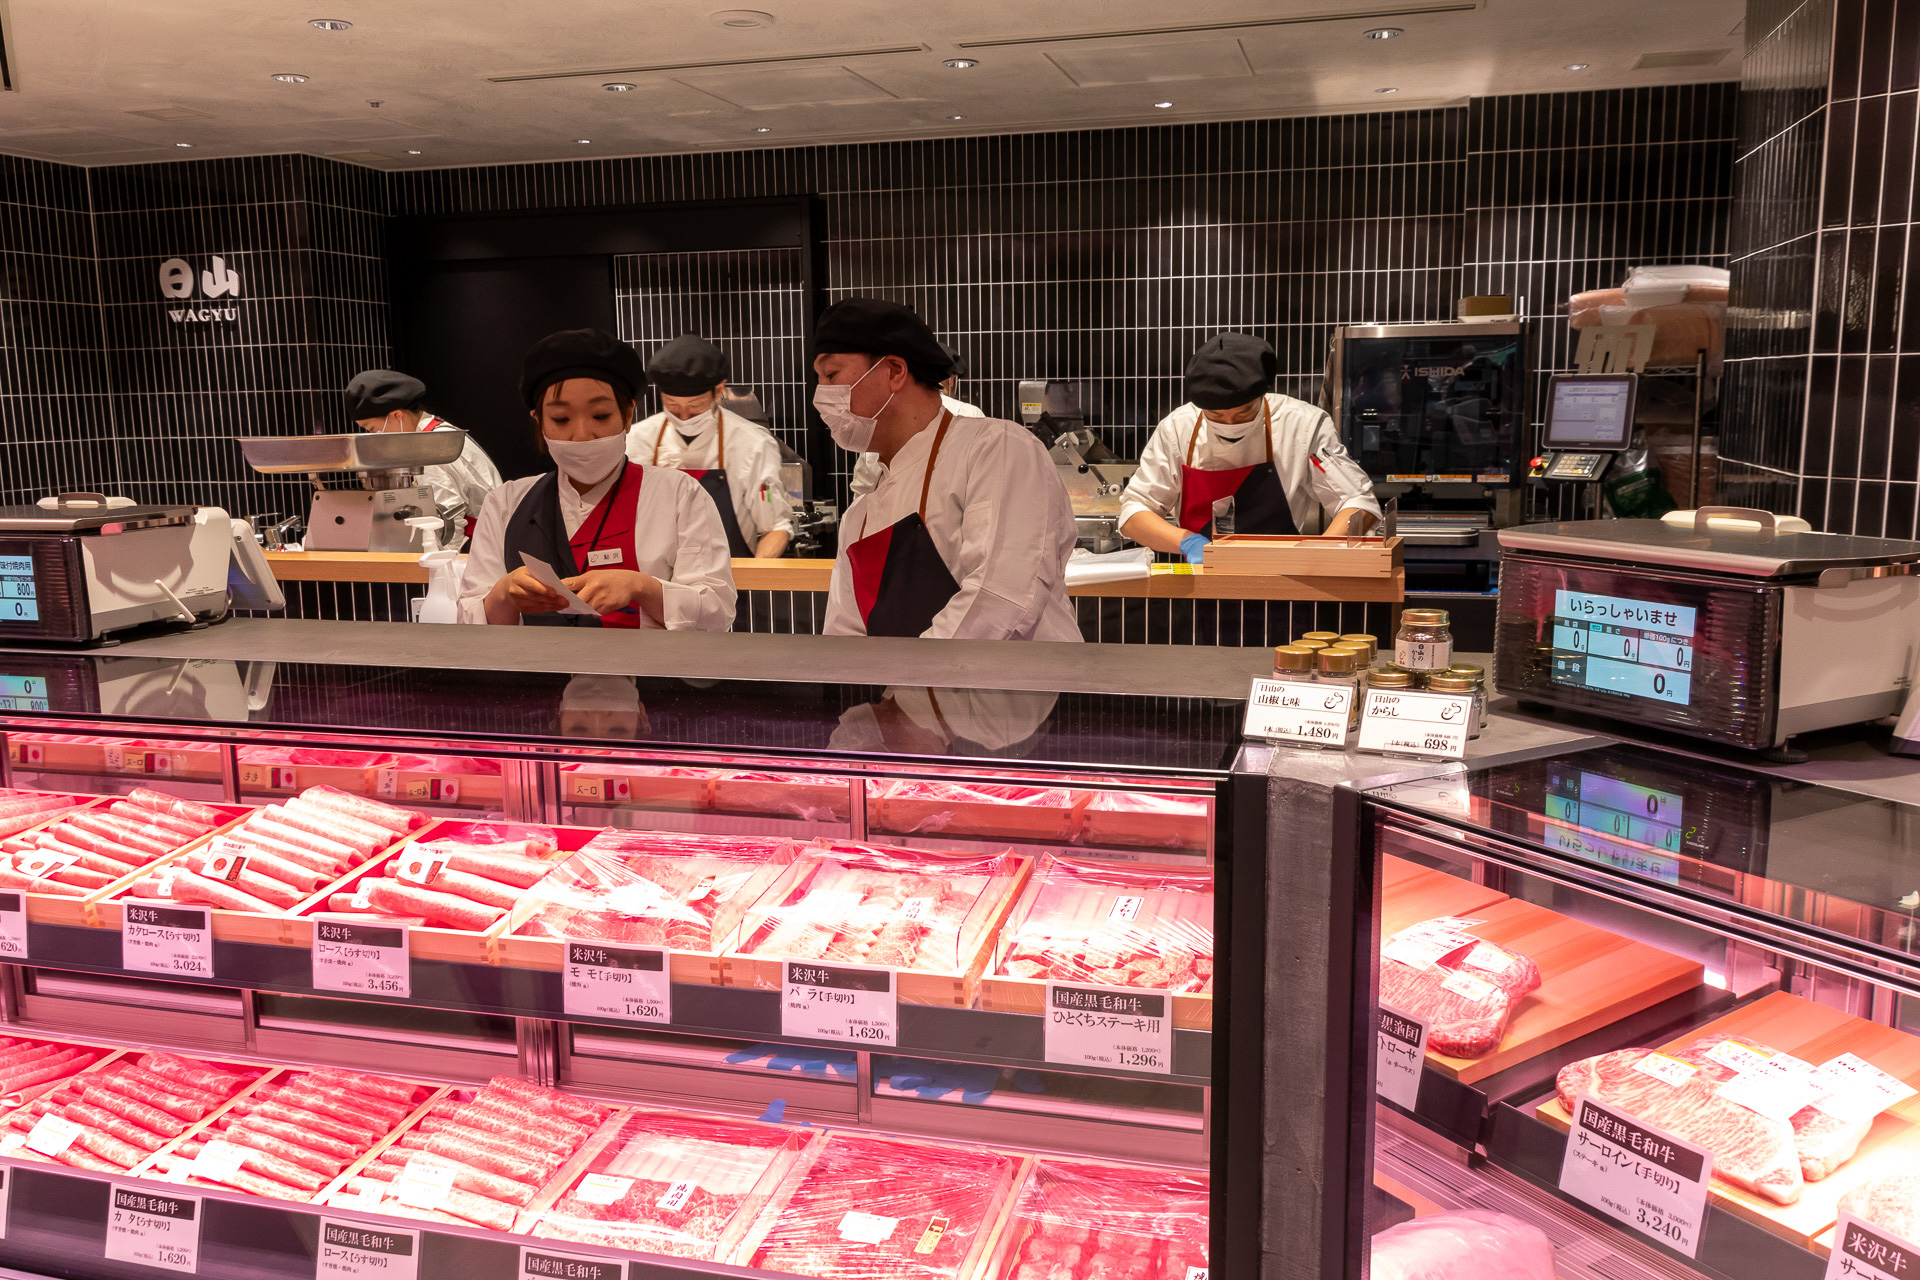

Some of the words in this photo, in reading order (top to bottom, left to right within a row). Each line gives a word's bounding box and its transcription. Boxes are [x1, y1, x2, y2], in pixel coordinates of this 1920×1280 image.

[159, 255, 239, 298] 日山
[168, 308, 237, 322] WAGYU
[1414, 366, 1465, 377] ISHIDA
[1570, 598, 1677, 627] いらっしゃいませ
[1260, 684, 1285, 692] 日山の
[1374, 695, 1400, 704] 日山の
[1371, 705, 1400, 717] からし
[129, 907, 158, 922] 米沢牛
[128, 924, 201, 943] カタロース【うす切り】
[320, 925, 352, 940] 米沢牛
[318, 943, 381, 960] ロース【うす切り】
[572, 947, 607, 963] 米沢牛
[791, 967, 829, 983] 米沢牛
[1054, 989, 1142, 1012] 国産黒毛和牛
[1052, 1011, 1160, 1033] ひとくちステーキ用
[1582, 1106, 1676, 1164] 国産黒毛和牛
[1577, 1130, 1681, 1195] サーロイン【手切り】
[116, 1192, 179, 1215] 国産黒毛和牛
[326, 1227, 395, 1250] 国産黒毛和牛
[324, 1247, 388, 1268] ロース【うす切り】
[1847, 1231, 1908, 1272] 米沢牛
[526, 1255, 602, 1280] 国産黒毛和牛
